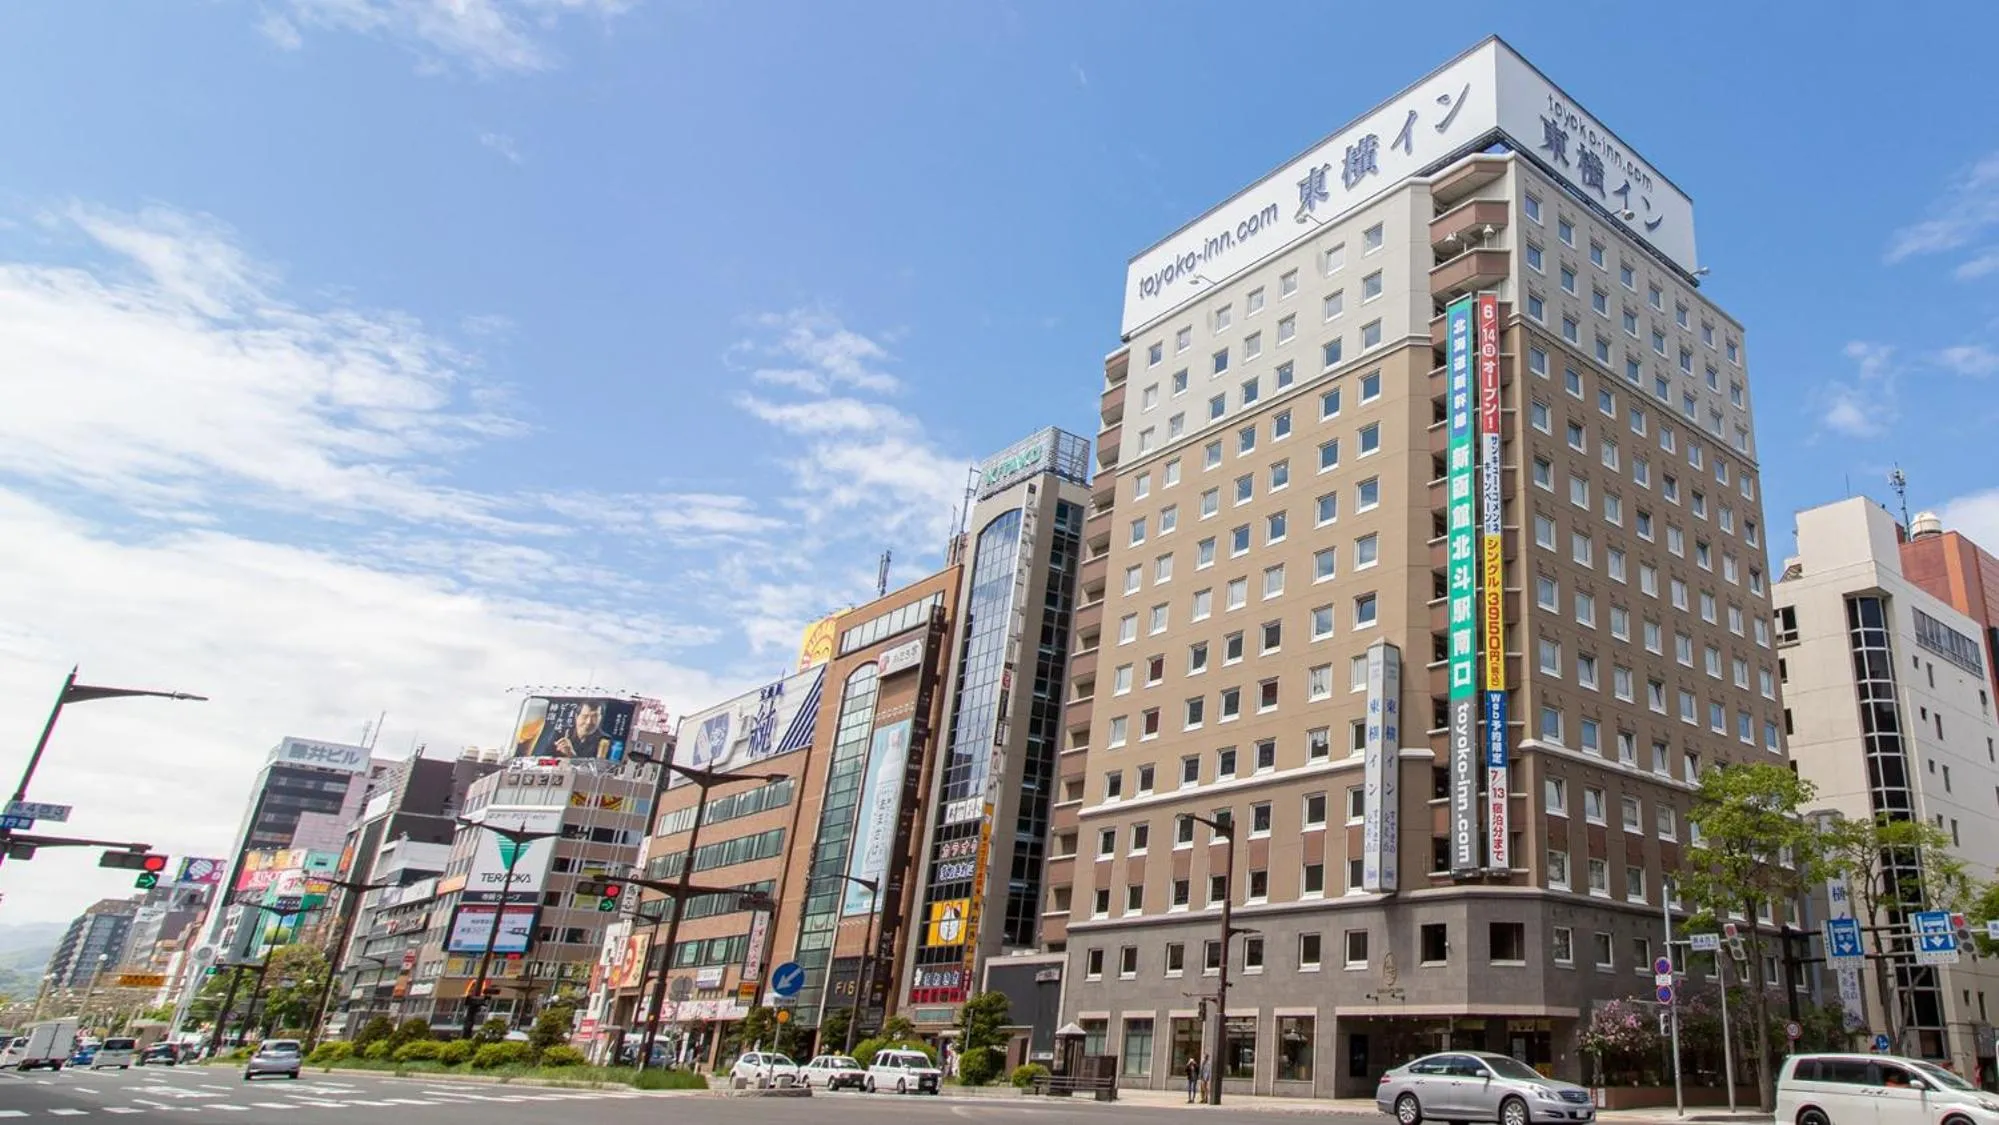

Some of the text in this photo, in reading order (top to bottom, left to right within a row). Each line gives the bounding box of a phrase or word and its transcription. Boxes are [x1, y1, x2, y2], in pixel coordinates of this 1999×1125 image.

[1294, 82, 1470, 220] 東横イン
[1539, 114, 1664, 232] 東横イン
[1547, 94, 1654, 193] toyoko-inn.com
[1138, 202, 1278, 299] toyoko-inn.com
[1385, 699, 1398, 796] 東横イン
[1456, 702, 1471, 864] toyoko-inn.com
[481, 872, 532, 884] TERAOKA
